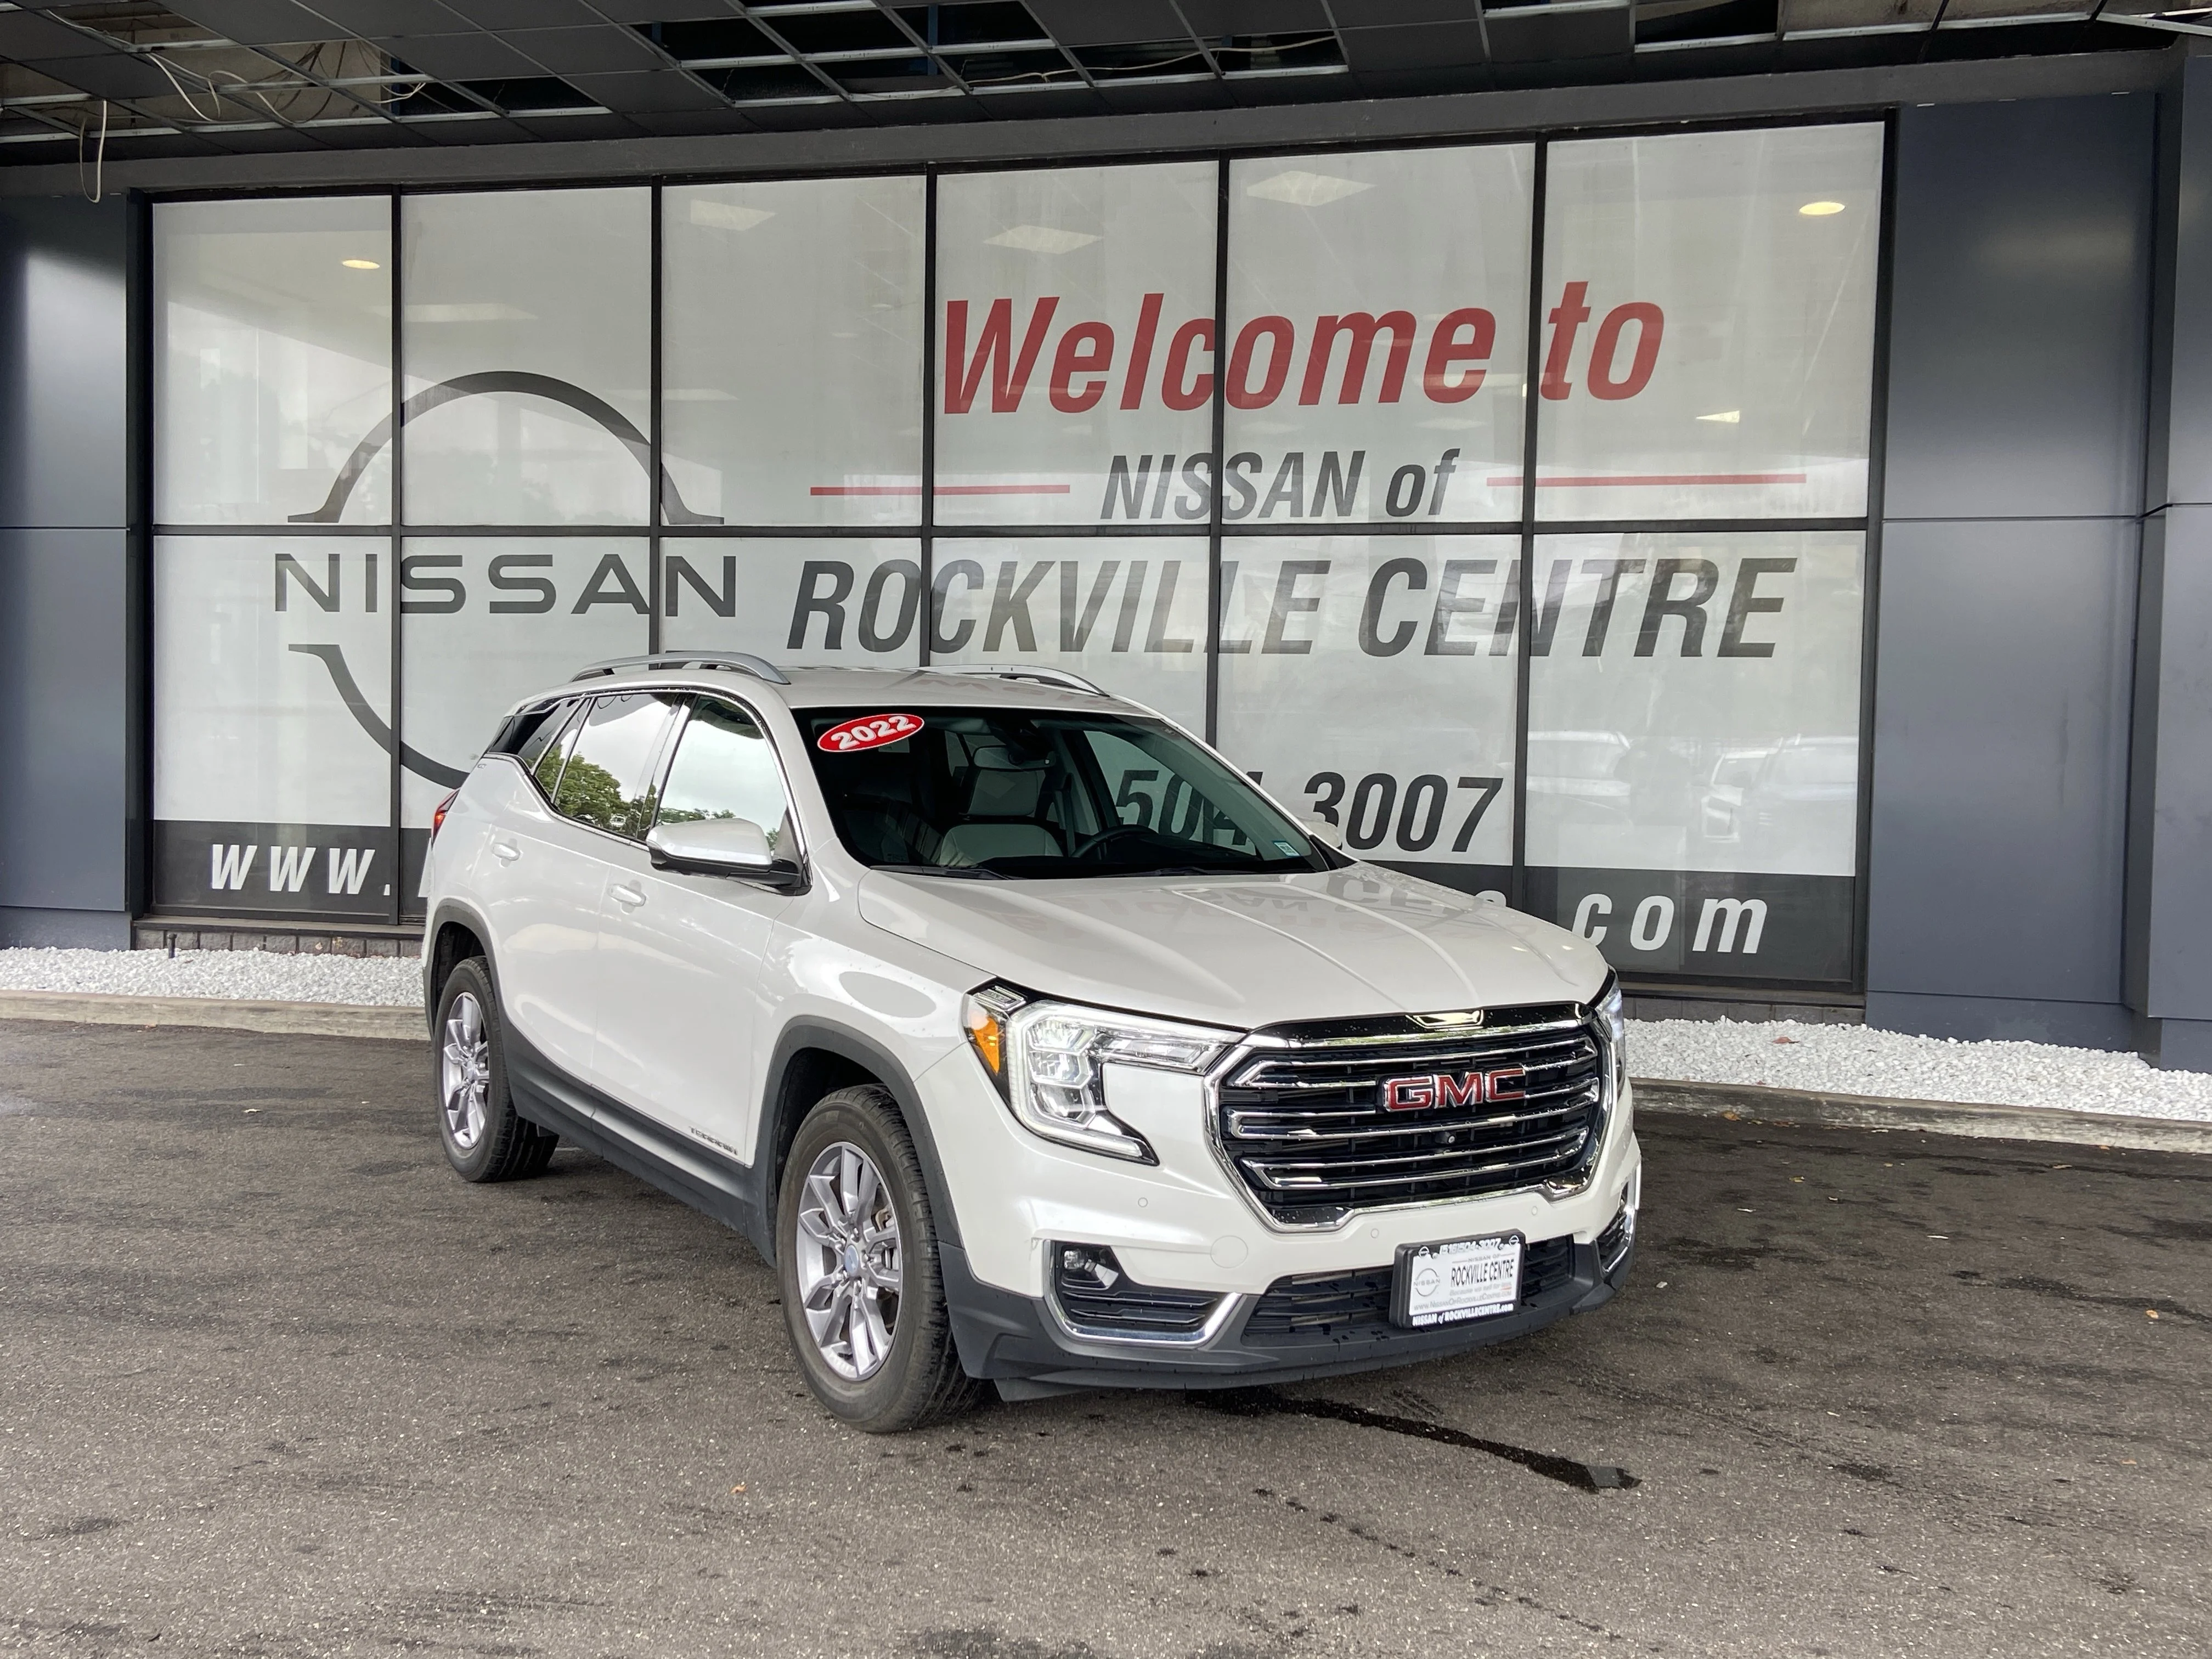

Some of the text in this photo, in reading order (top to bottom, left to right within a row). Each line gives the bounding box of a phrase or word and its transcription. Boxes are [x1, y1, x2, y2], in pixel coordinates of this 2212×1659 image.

[944, 280, 1666, 414] Welcome to
[1100, 448, 1460, 520] NISSAN of
[275, 553, 736, 617] NISSAN
[786, 557, 1798, 657] ROCKVILLE CENTRE
[831, 715, 917, 750] 2022
[1385, 1068, 1526, 1112] GMC
[1413, 1278, 1440, 1287] NISSAN
[1451, 1259, 1514, 1286] ROCKVILLE CENTRE
[1413, 1313, 1437, 1326] NISSAN
